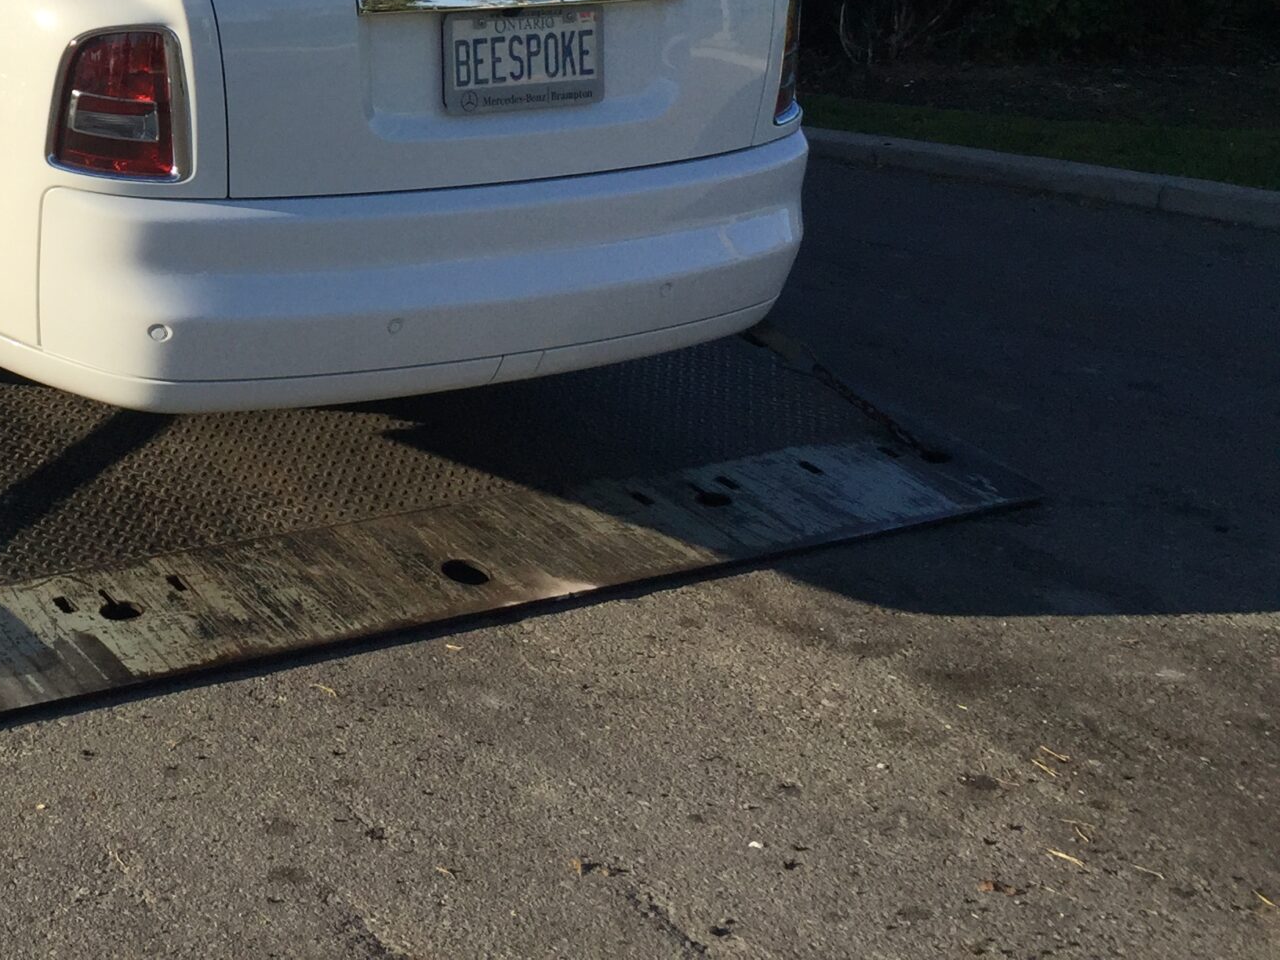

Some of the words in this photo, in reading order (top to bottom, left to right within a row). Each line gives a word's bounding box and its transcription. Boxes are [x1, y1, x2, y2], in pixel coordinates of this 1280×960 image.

[494, 17, 555, 34] ONTARIO
[454, 29, 595, 87] BEESPOKE
[482, 93, 546, 107] Mercedes-Benz
[551, 88, 593, 102] Brampton
